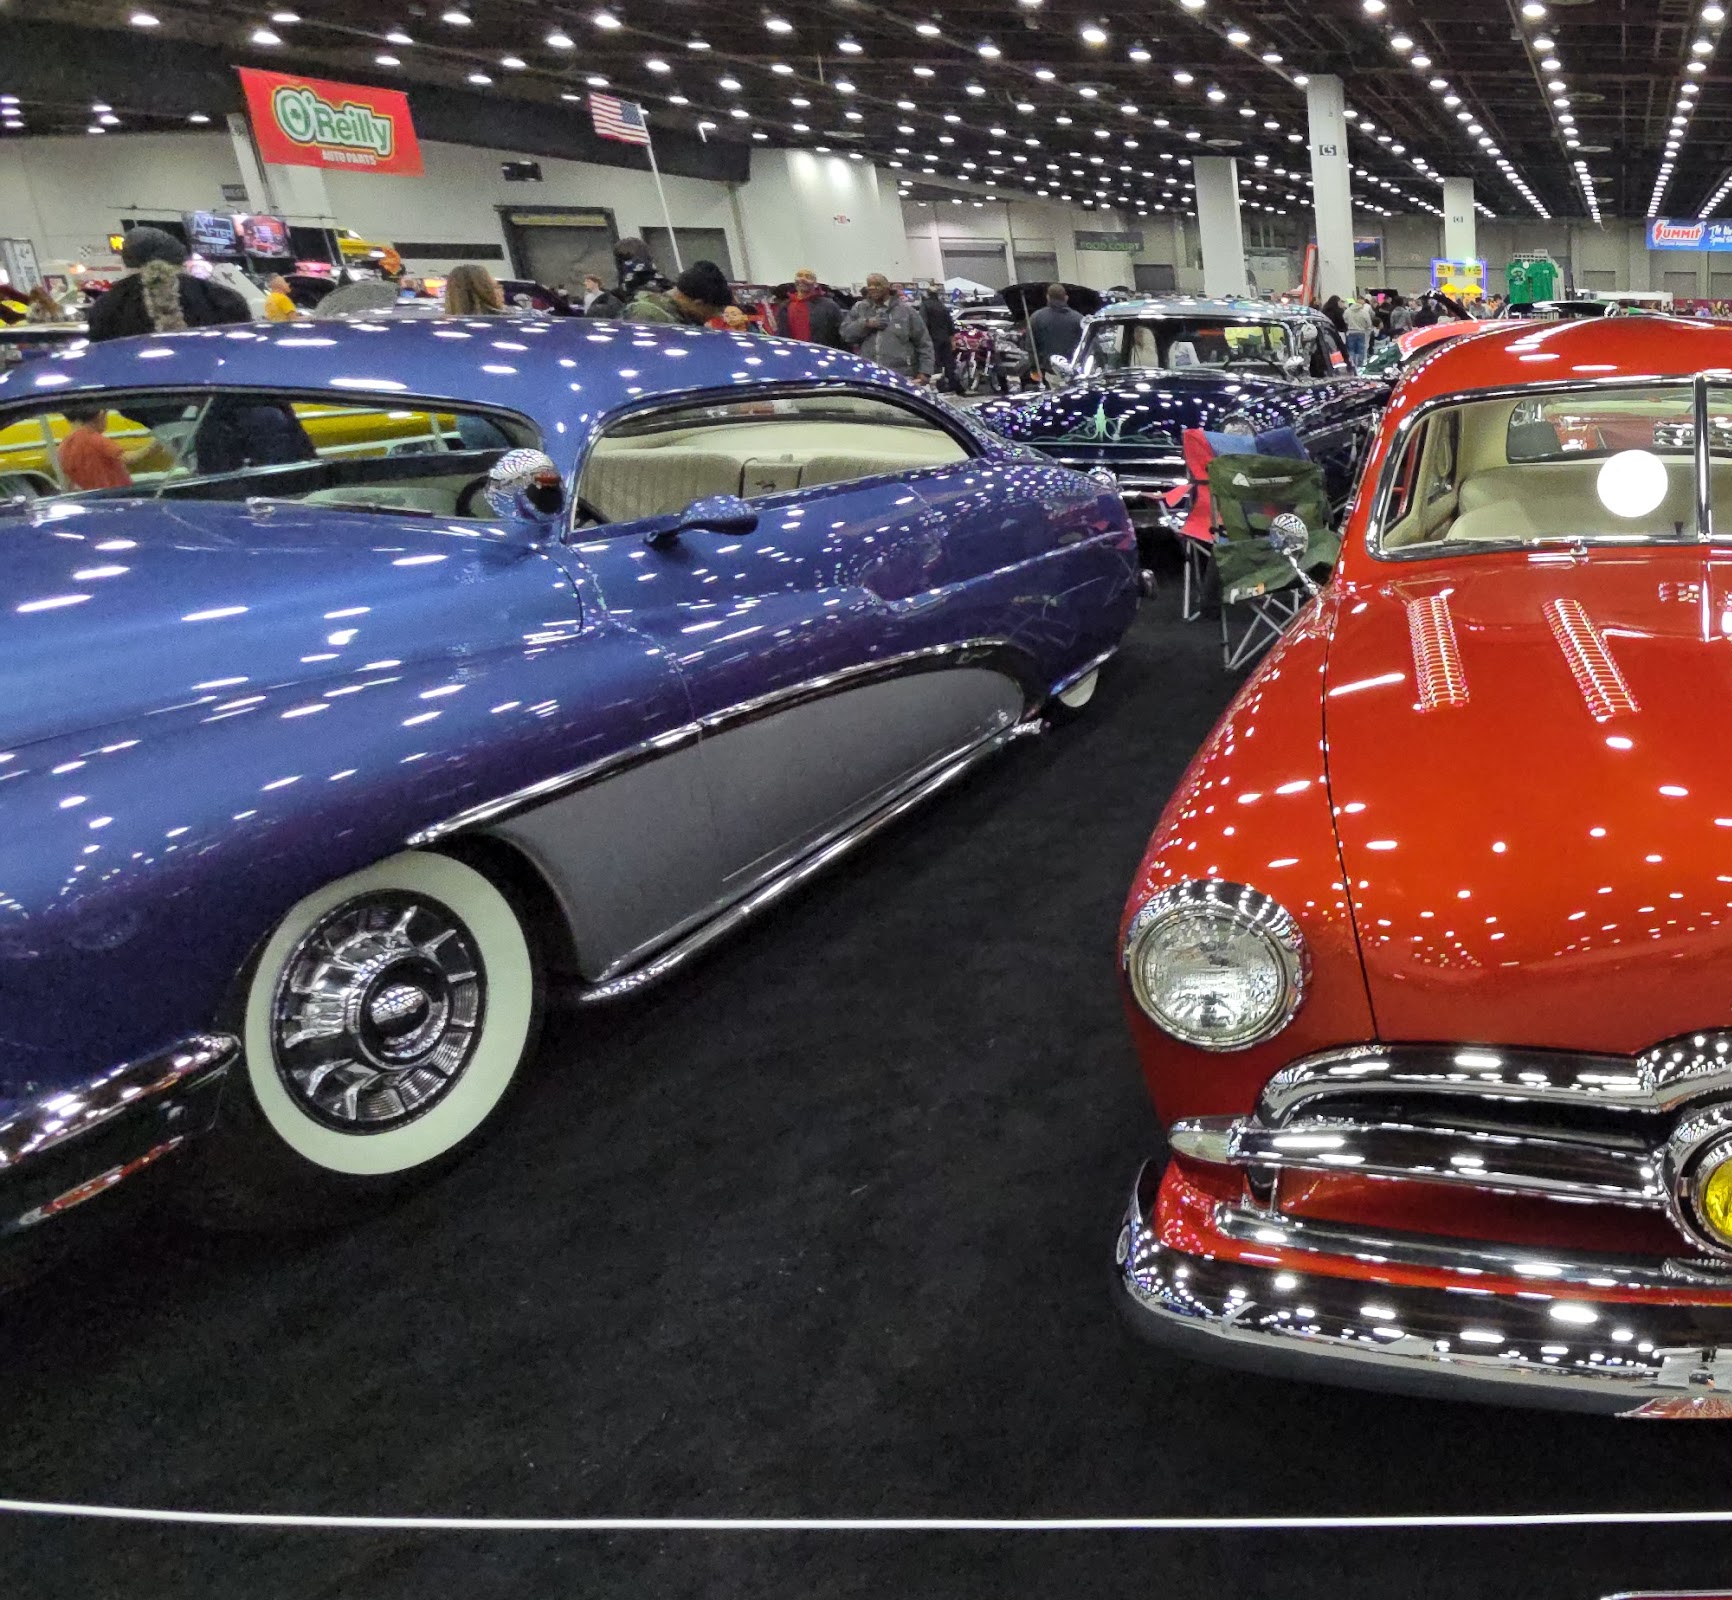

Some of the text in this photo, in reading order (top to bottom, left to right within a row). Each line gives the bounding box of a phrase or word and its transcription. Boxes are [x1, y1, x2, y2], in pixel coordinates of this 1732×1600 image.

[278, 91, 390, 155] O'Reilly
[322, 149, 376, 166] AUTO PARTS
[1320, 145, 1336, 156] C5
[1080, 242, 1140, 250] FOOD COURT
